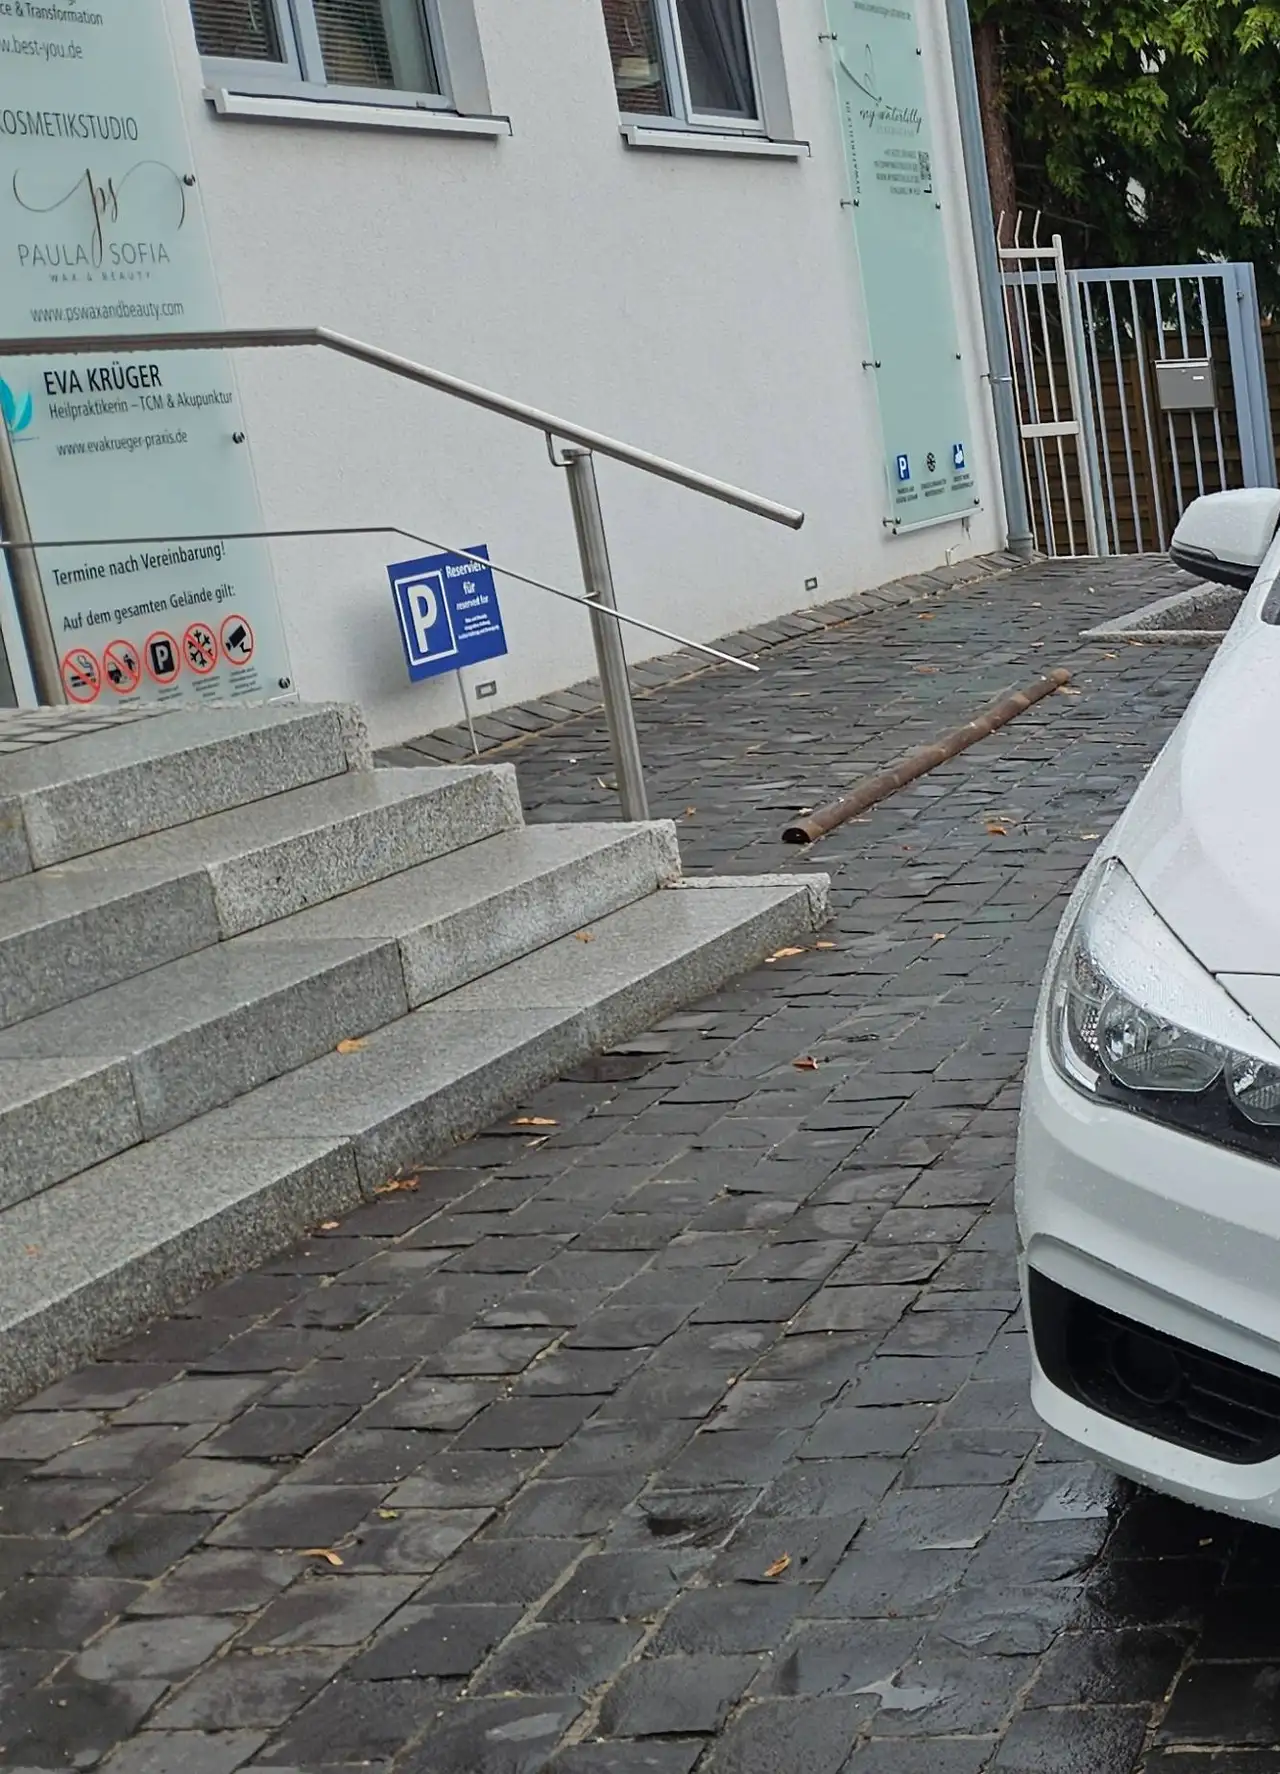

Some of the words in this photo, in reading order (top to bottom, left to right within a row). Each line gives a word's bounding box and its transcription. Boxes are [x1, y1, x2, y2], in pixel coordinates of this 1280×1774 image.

[15, 1, 24, 17] &
[24, 2, 104, 26] Transformation
[17, 243, 90, 267] PAULA
[109, 242, 170, 265] SOFIA
[50, 273, 77, 283] WAX
[101, 271, 151, 282] BEAUTY
[30, 300, 185, 324] www.pswaxandbeauty.com
[43, 369, 83, 396] EVA
[86, 360, 163, 392] KRÜGER
[48, 397, 129, 421] Heilpraktikerin
[167, 393, 175, 409] &
[177, 389, 234, 409] Akupunktur
[55, 428, 188, 457] www.evakrueger-praxis.de
[53, 562, 107, 587] Termine
[108, 555, 140, 577] nach
[140, 540, 227, 570] Vereinbarung!
[463, 581, 475, 595] für
[62, 612, 83, 632] Auf
[86, 610, 112, 627] dem
[114, 598, 168, 625] gesamten
[169, 587, 213, 609] Gelände
[215, 583, 236, 603] gilt:
